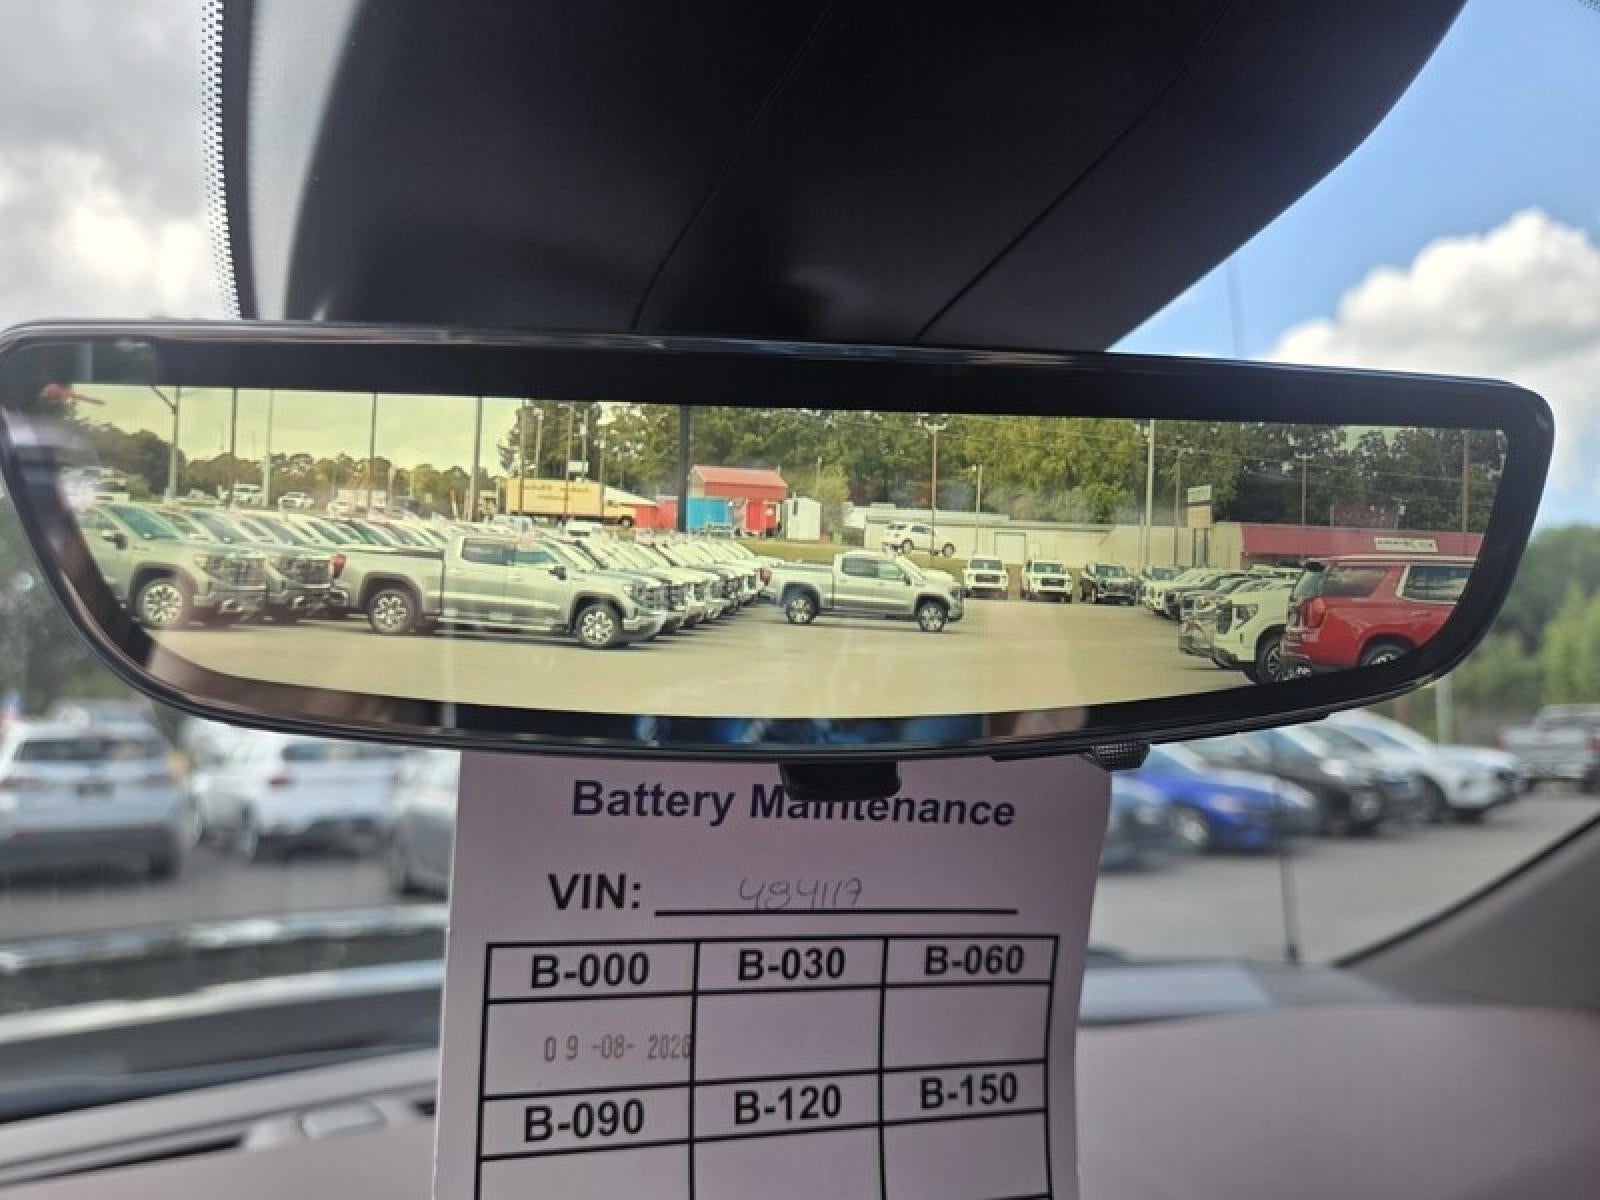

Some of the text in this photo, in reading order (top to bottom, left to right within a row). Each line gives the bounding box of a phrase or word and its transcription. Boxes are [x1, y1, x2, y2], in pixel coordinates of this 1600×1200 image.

[572, 779, 736, 827] Battery
[548, 873, 641, 911] VIN:
[531, 952, 650, 989] B-000
[737, 947, 846, 981] B-030
[924, 944, 1025, 976] B-060
[734, 1083, 842, 1126] B-120
[920, 1071, 1018, 1110] B-150
[524, 1099, 645, 1143] B-090
